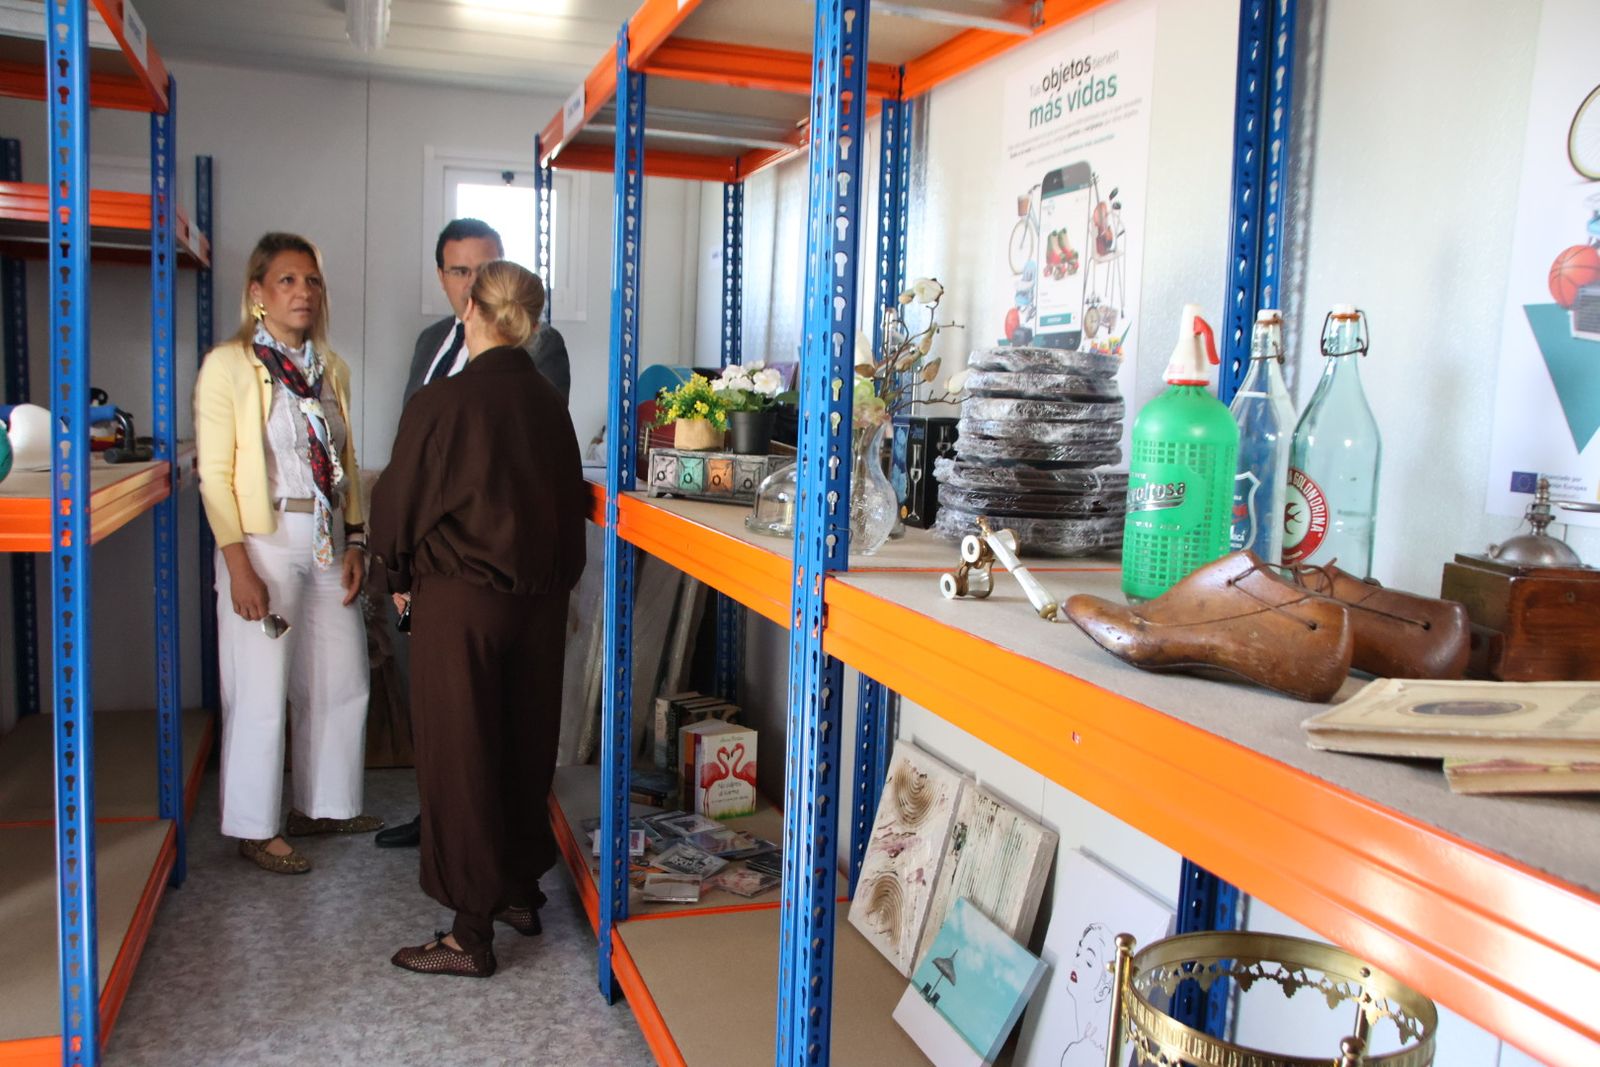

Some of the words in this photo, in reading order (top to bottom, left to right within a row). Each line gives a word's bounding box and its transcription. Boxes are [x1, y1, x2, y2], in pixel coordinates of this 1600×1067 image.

[1042, 55, 1092, 92] objetos
[1029, 92, 1062, 129] más
[1067, 74, 1118, 112] vidas
